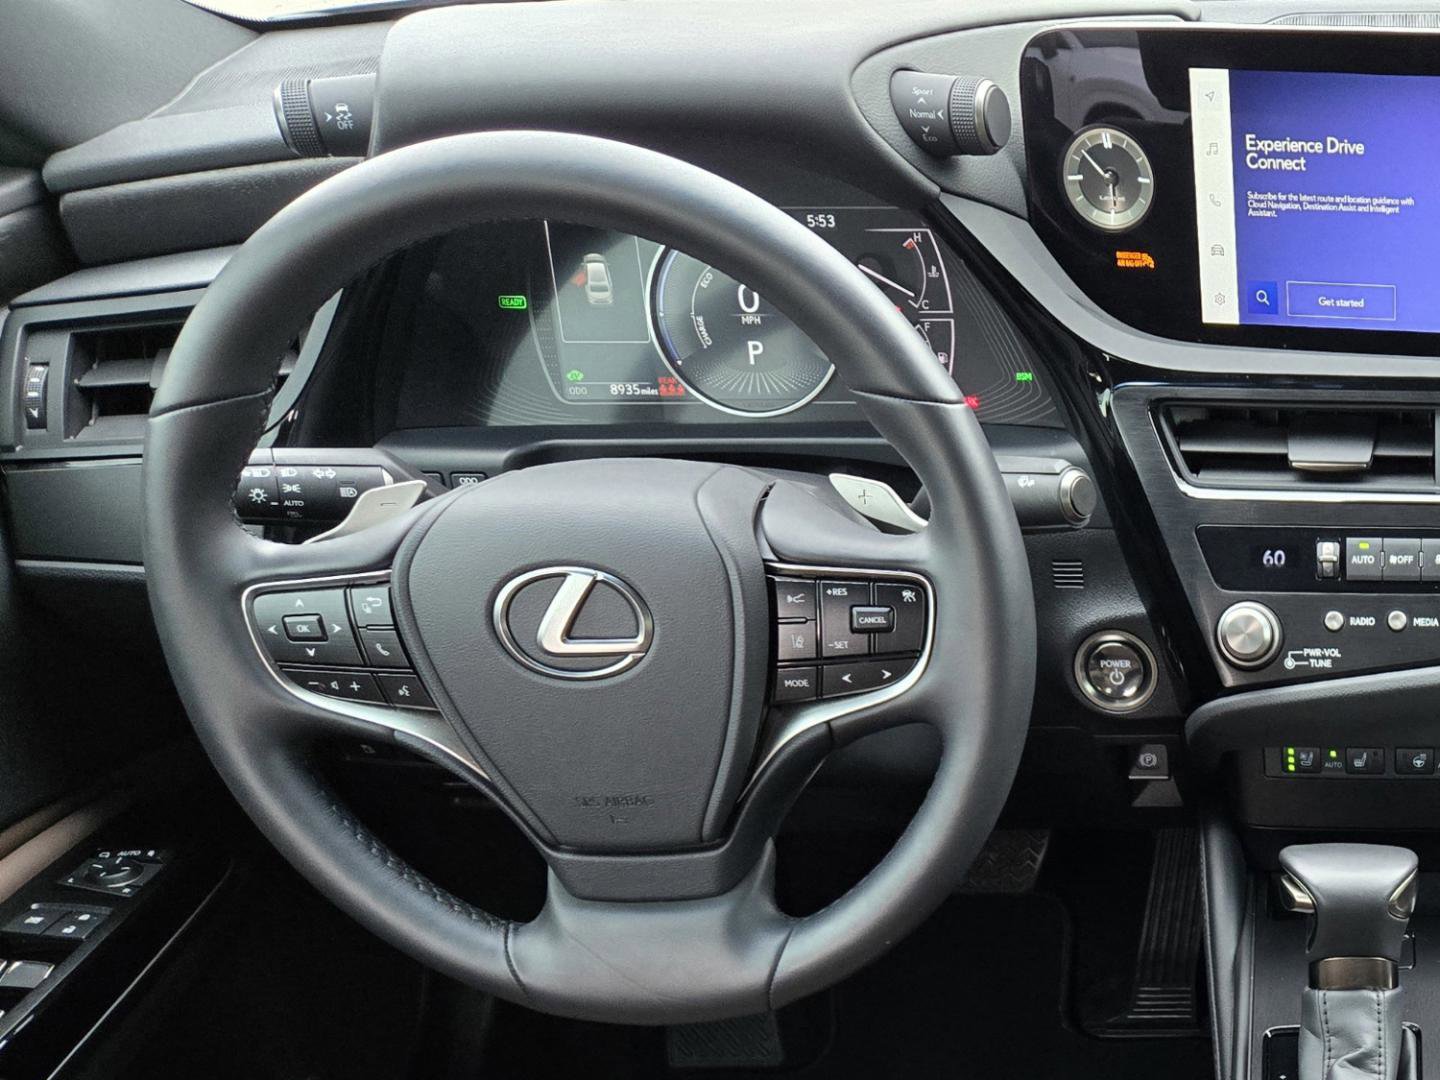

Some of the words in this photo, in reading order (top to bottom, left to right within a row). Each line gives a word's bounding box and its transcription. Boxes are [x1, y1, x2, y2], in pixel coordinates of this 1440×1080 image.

[909, 108, 936, 120] Normal
[1245, 134, 1323, 155] Experience
[1326, 136, 1365, 155] Drive
[1245, 153, 1307, 172] Connect
[1246, 191, 1278, 201] Subscribe
[1278, 192, 1287, 201] for
[1288, 192, 1299, 201] the
[1299, 193, 1317, 203] latest
[1317, 195, 1335, 203] route
[1335, 195, 1346, 204] and
[1347, 195, 1371, 205] location
[1372, 196, 1400, 206] guidance
[1400, 197, 1415, 206] with
[1247, 200, 1266, 209] Cloud
[1303, 202, 1338, 211] Destination
[1339, 203, 1356, 212] Assist
[1357, 204, 1369, 213] and
[1370, 204, 1400, 215] Intelligent
[807, 213, 835, 228] 5:53
[914, 232, 922, 242] H
[700, 272, 713, 289] ECO
[501, 298, 523, 306] READY
[922, 300, 930, 310] C
[1318, 296, 1334, 307] Get
[1335, 298, 1365, 308] started
[741, 315, 762, 325] MPH
[924, 322, 931, 331] F
[747, 340, 764, 366] P
[610, 383, 641, 396] 8935
[641, 387, 659, 396] miles
[1262, 550, 1286, 567] 60
[1352, 554, 1375, 565] AUTO
[1397, 555, 1414, 565] OFF
[858, 616, 887, 625] CANCEL
[1350, 616, 1376, 626] RADIO
[1413, 617, 1439, 627] MEDIA
[296, 624, 310, 633] OK
[1100, 659, 1132, 668] POWER
[1310, 658, 1332, 668] TUNE
[784, 679, 809, 688] MODE
[1324, 761, 1342, 769] AUTO
